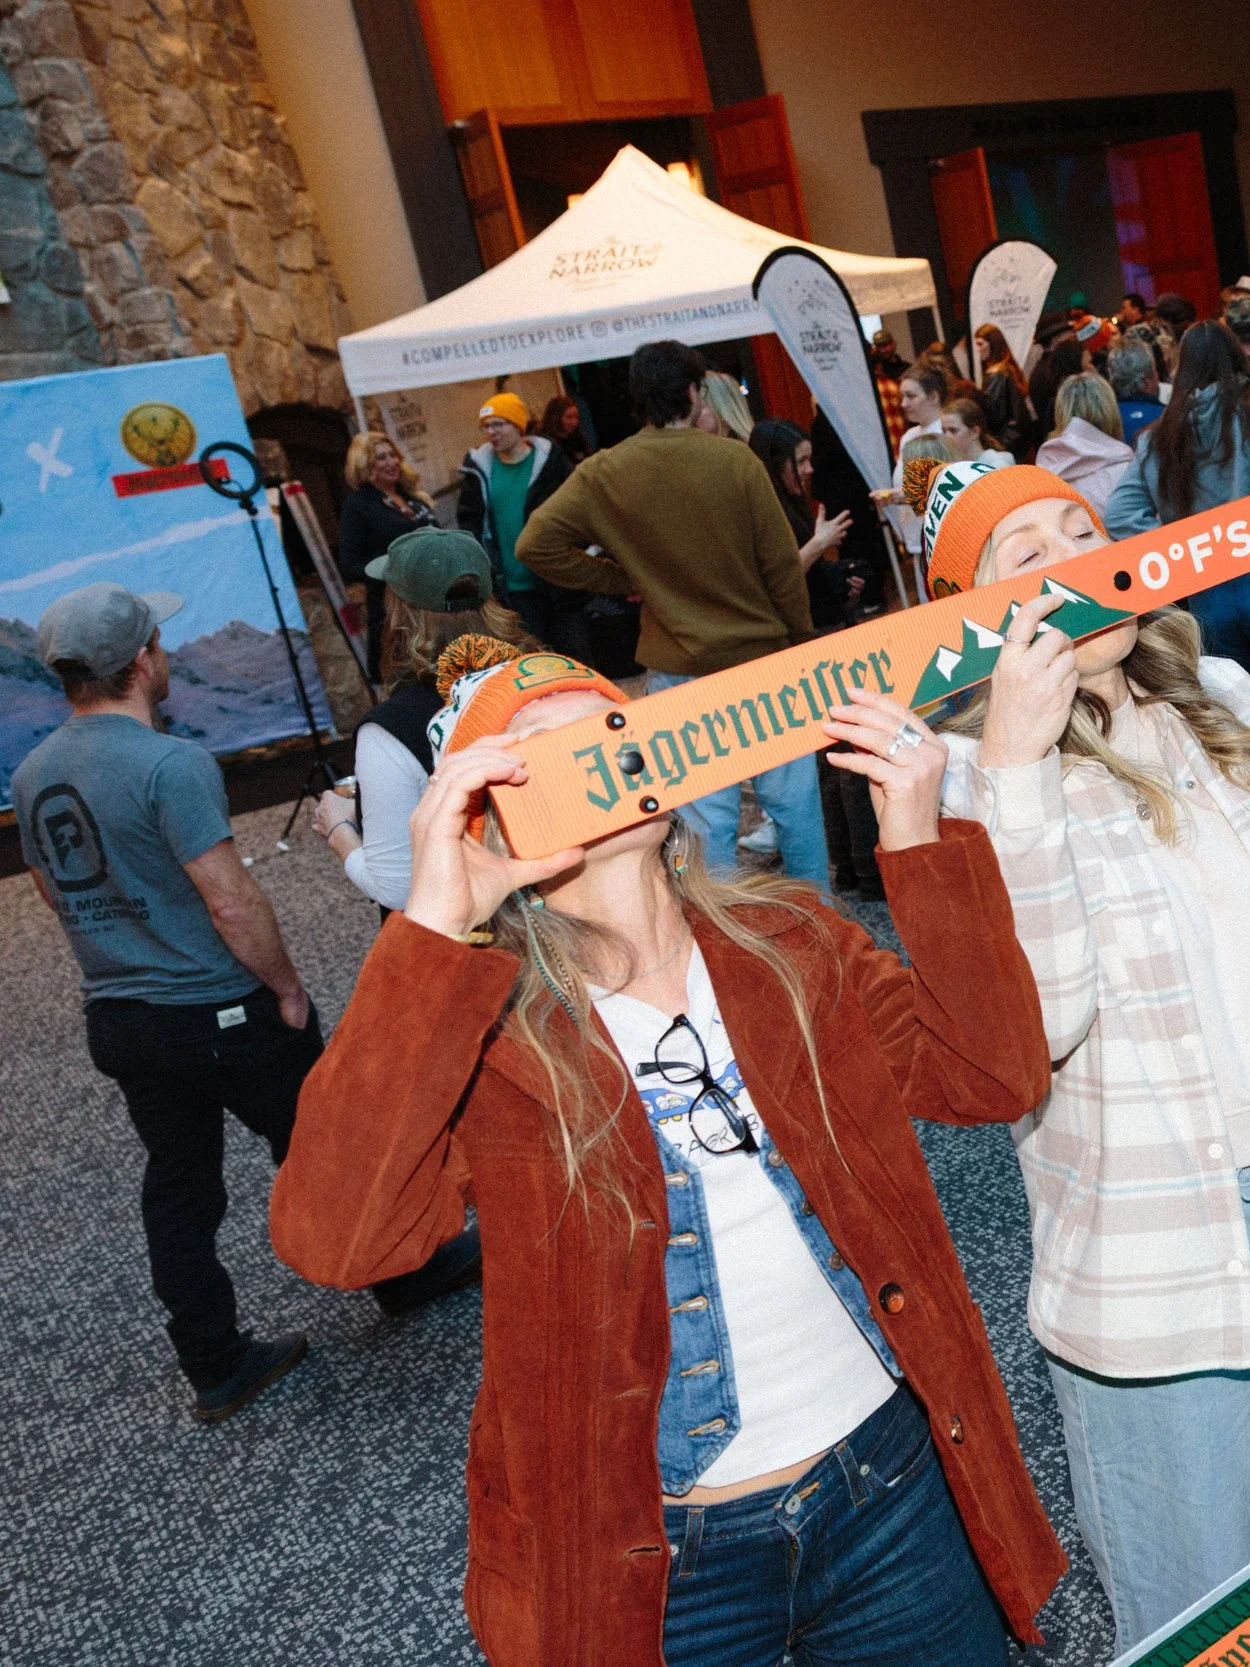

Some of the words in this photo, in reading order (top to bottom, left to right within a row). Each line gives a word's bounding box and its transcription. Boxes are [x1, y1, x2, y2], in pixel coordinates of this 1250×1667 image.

[555, 243, 644, 264] STRAIT
[547, 257, 660, 280] NARROW
[401, 324, 586, 366] #COMPELLEDTOEXPLORE
[611, 300, 761, 334] @THESTRAITANDNARRO
